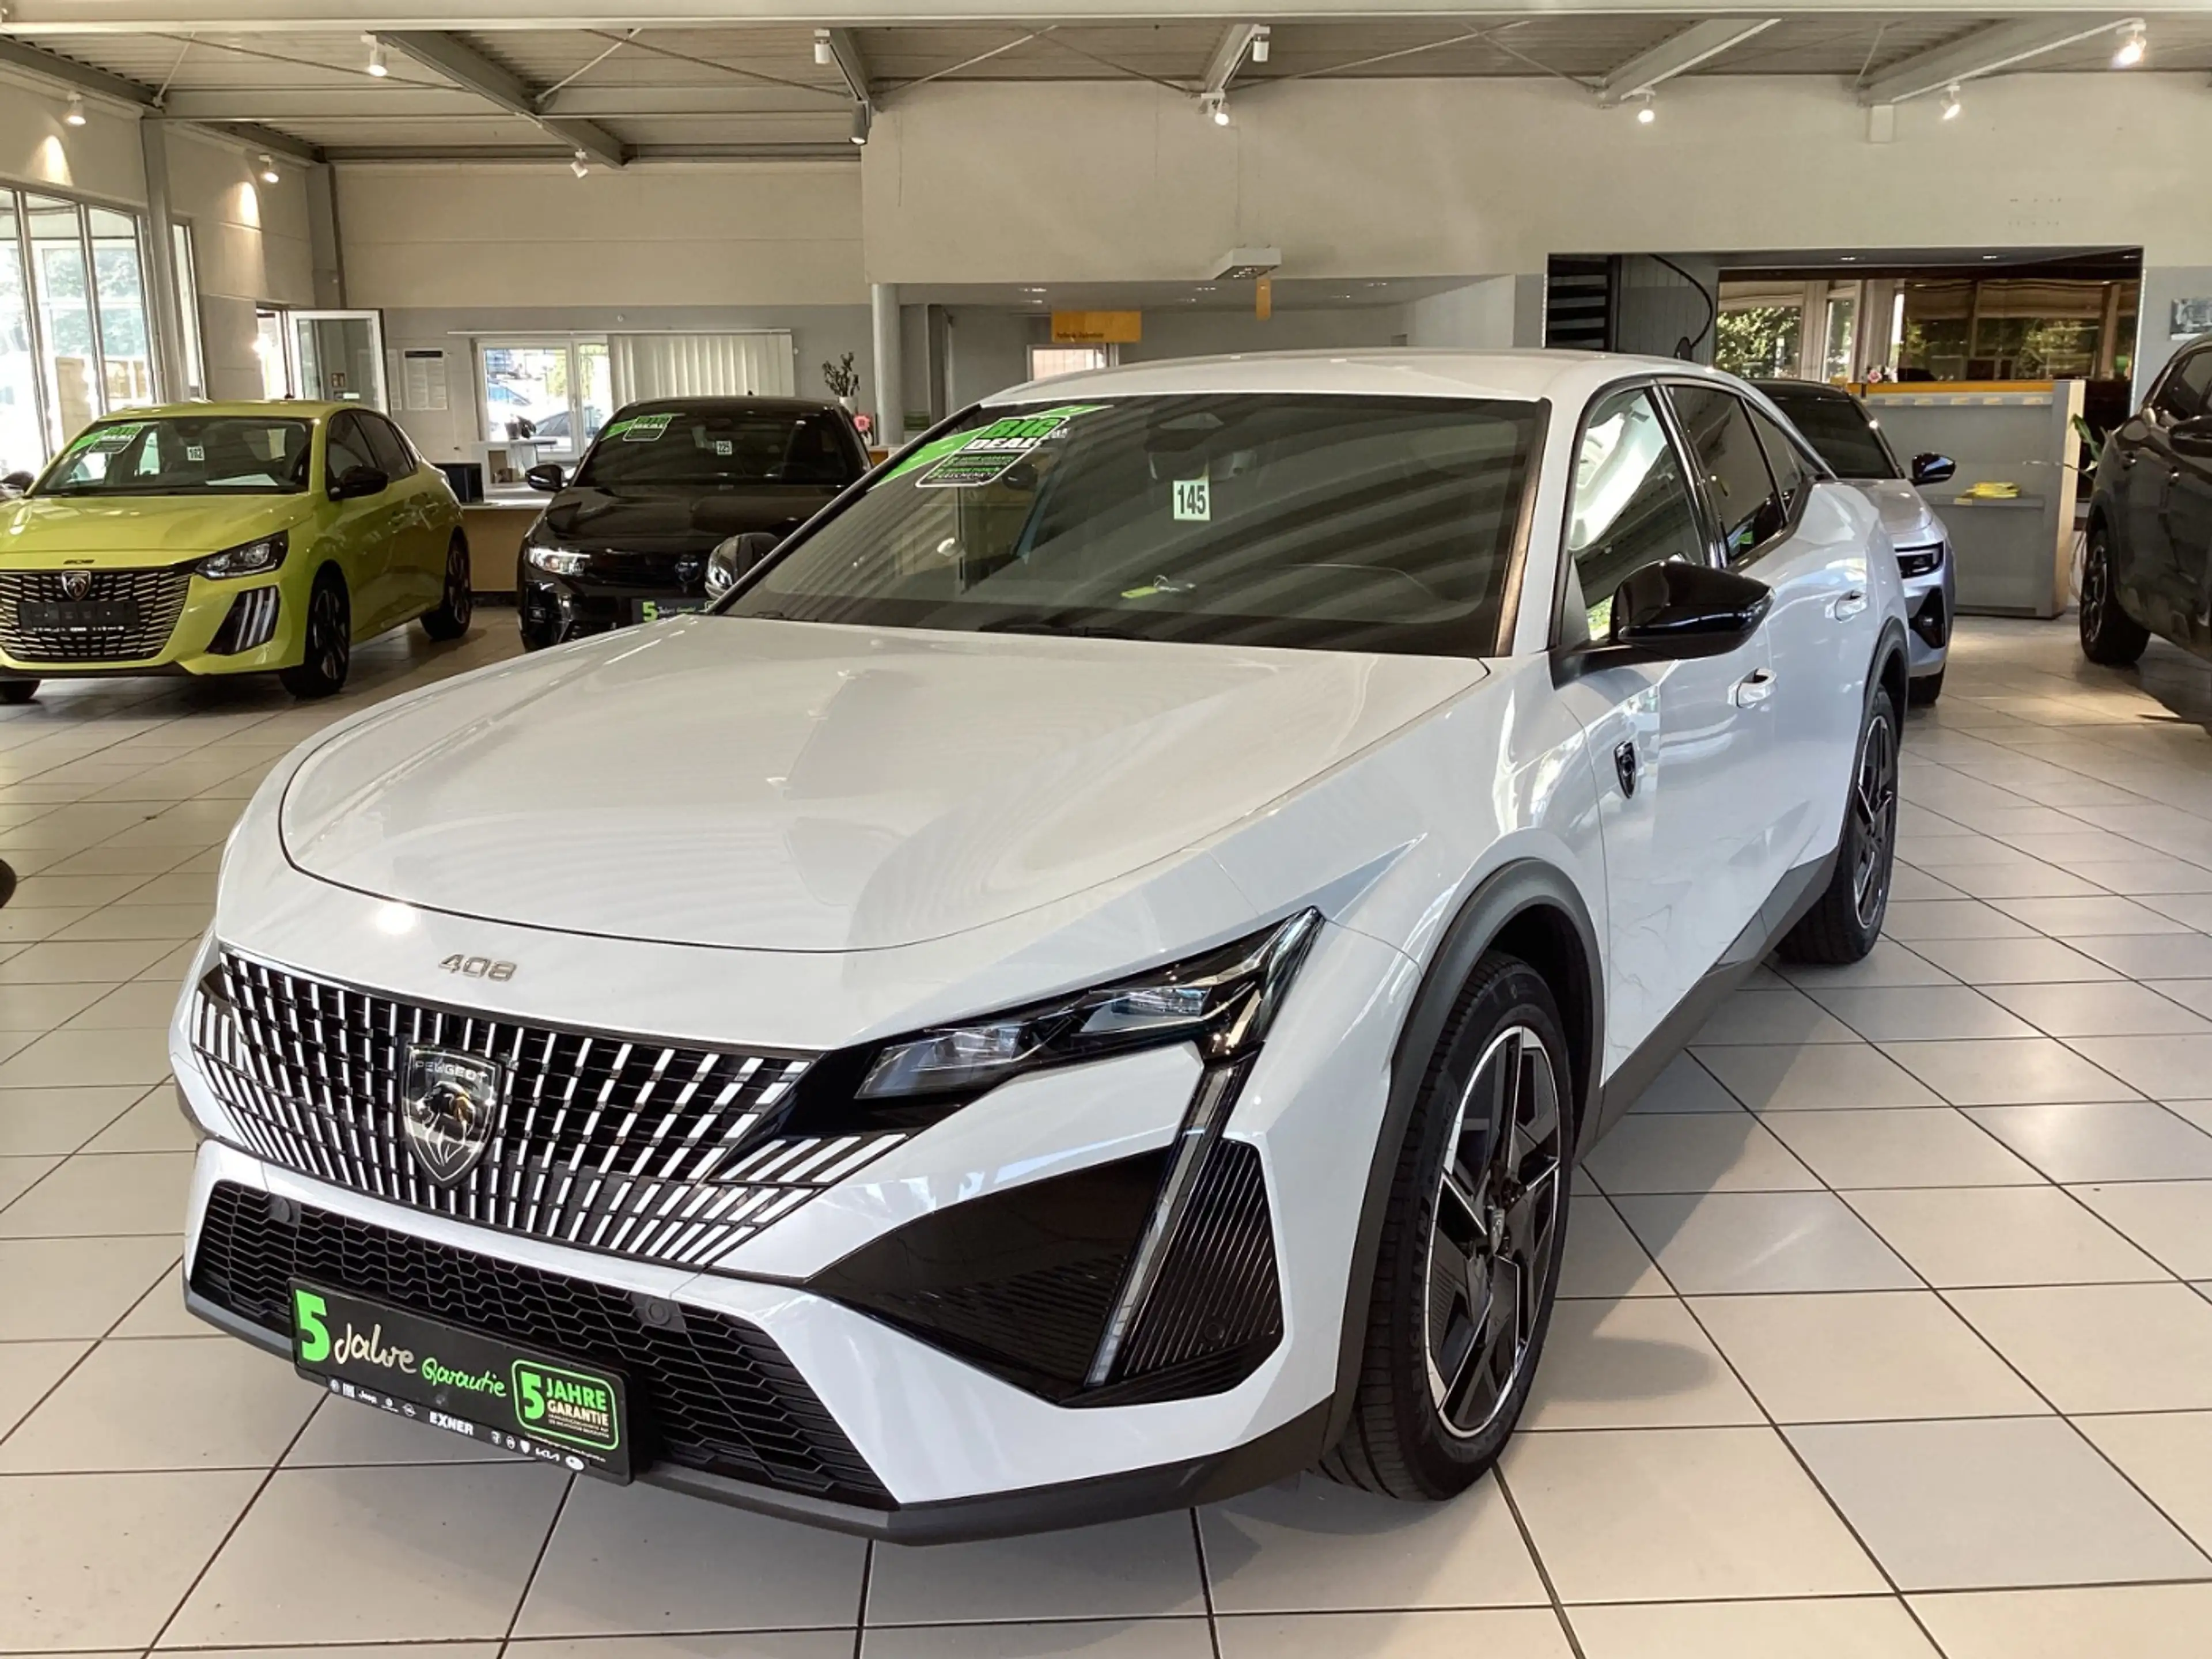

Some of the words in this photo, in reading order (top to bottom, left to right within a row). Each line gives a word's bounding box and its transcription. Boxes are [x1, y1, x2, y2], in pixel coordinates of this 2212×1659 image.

[980, 417, 1060, 437] BIG
[963, 437, 1039, 450] DEAL
[1177, 484, 1206, 514] 145
[643, 601, 658, 622] 5
[438, 954, 517, 982] 408
[415, 1060, 488, 1083] PEUGEOT
[296, 1289, 331, 1362] 5
[334, 1323, 417, 1374] Jahre
[421, 1357, 507, 1397] Garantie
[521, 1371, 544, 1419] 5
[546, 1377, 607, 1411] JAHRE
[429, 1411, 474, 1436] EXNER
[548, 1399, 609, 1426] GARANTIE
